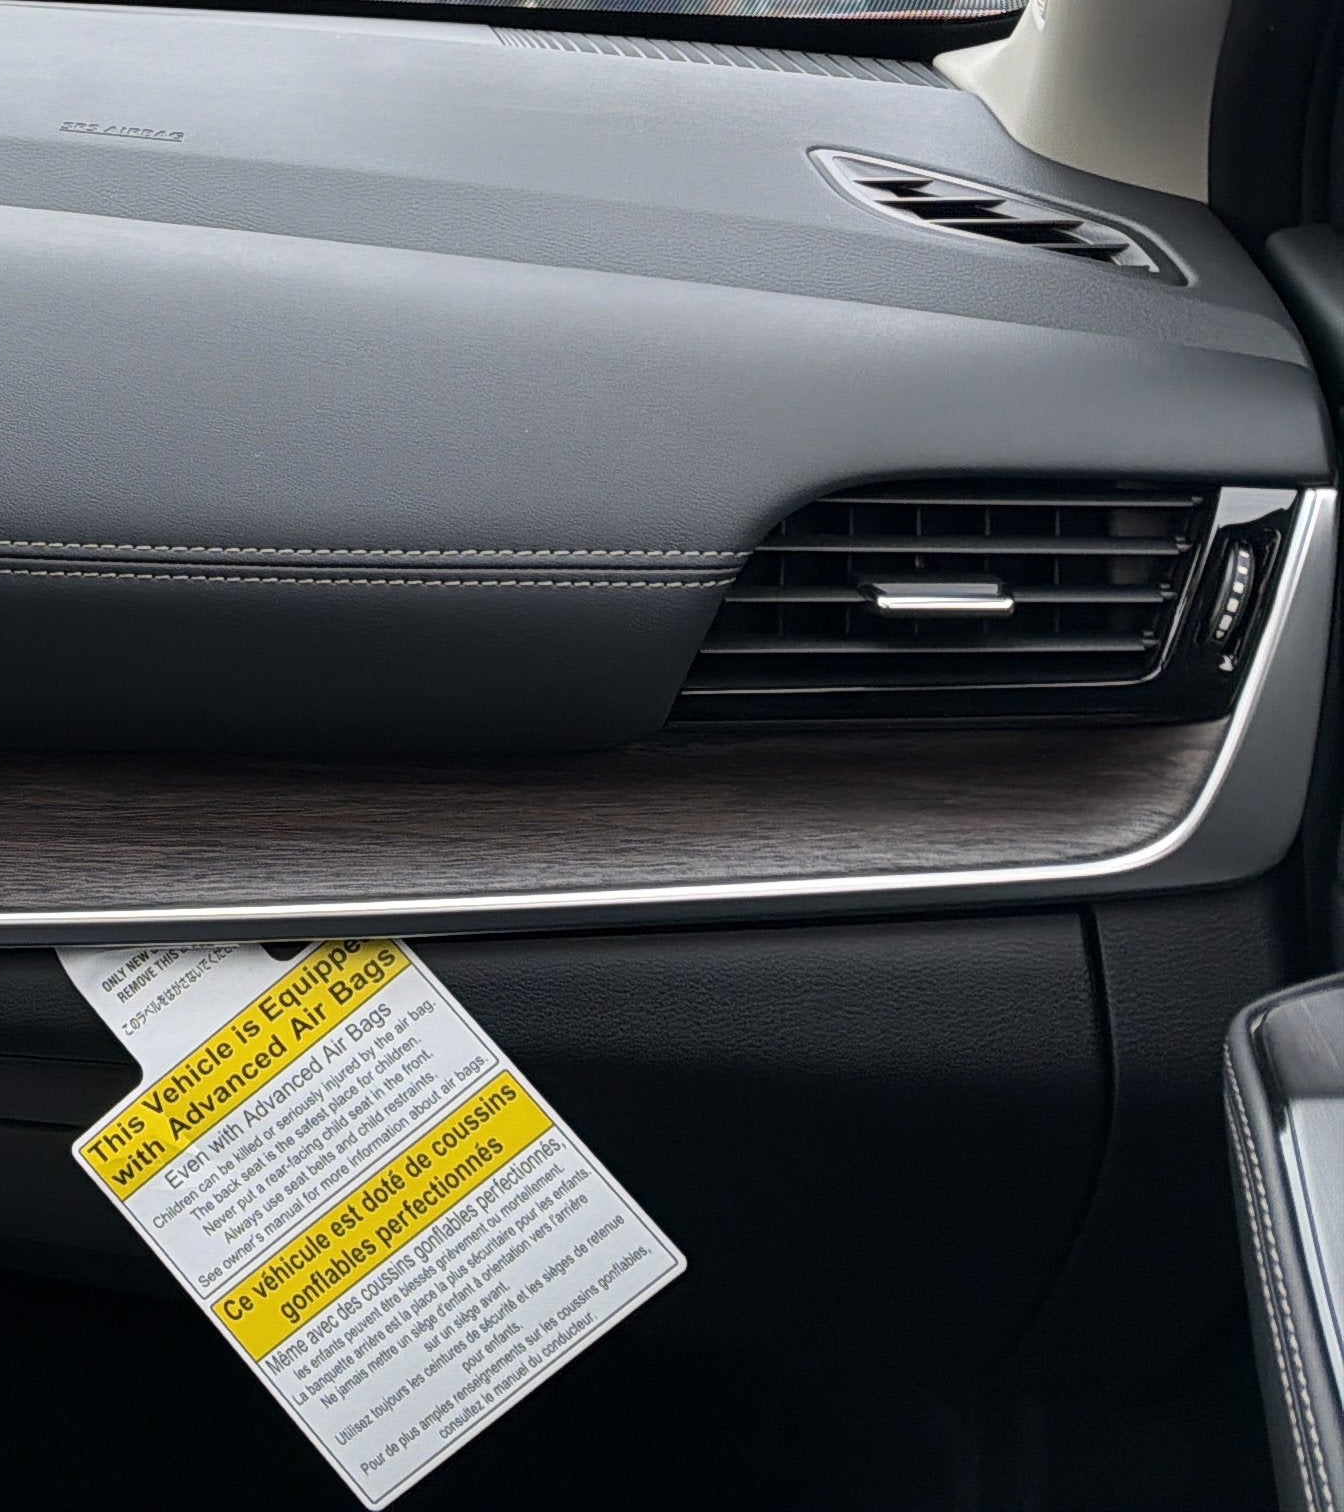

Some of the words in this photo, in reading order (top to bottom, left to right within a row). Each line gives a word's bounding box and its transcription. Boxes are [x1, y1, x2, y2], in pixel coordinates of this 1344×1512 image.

[60, 121, 99, 133] SRS
[102, 125, 185, 140] AIRBAG
[87, 1114, 145, 1165] This
[140, 1041, 234, 1114] Vehicle
[229, 1019, 261, 1045] is
[257, 939, 374, 1023] Equippe
[101, 968, 126, 993] ONLY
[125, 950, 151, 974] NEW
[110, 1139, 166, 1186] with
[168, 1033, 288, 1142] Advanced
[289, 1001, 327, 1042] Air
[327, 948, 396, 1006] Bags
[116, 967, 158, 1003] REMOVE
[152, 949, 180, 973] THIS
[151, 1189, 200, 1229] Children
[197, 1172, 221, 1193] can
[215, 1159, 236, 1177] be
[231, 1133, 265, 1164] killed
[262, 1125, 277, 1141] or
[274, 1087, 325, 1131] seriously
[319, 1055, 362, 1093] injured
[356, 1045, 377, 1063] by
[372, 1030, 395, 1051] the
[393, 1016, 410, 1035] air
[406, 999, 437, 1022] bag.
[163, 1150, 211, 1190] Even
[206, 1123, 245, 1154] with
[242, 1054, 324, 1129] Advanced
[321, 1036, 348, 1065] Air
[343, 1002, 392, 1043] Bags
[222, 1294, 254, 1321] Ce
[250, 1232, 331, 1298] véhicule
[329, 1203, 365, 1238] est
[360, 1168, 406, 1213] doté
[404, 1152, 433, 1178] de
[430, 1084, 517, 1157] coussins
[263, 1338, 309, 1377] Même
[305, 1313, 340, 1345] avec
[335, 1295, 363, 1321] des
[359, 1253, 417, 1302] coussins
[412, 1203, 479, 1264] gonflables
[474, 1137, 567, 1215] perfectionnés,
[280, 1238, 377, 1325] gonflables
[374, 1137, 504, 1249] perfectionnés
